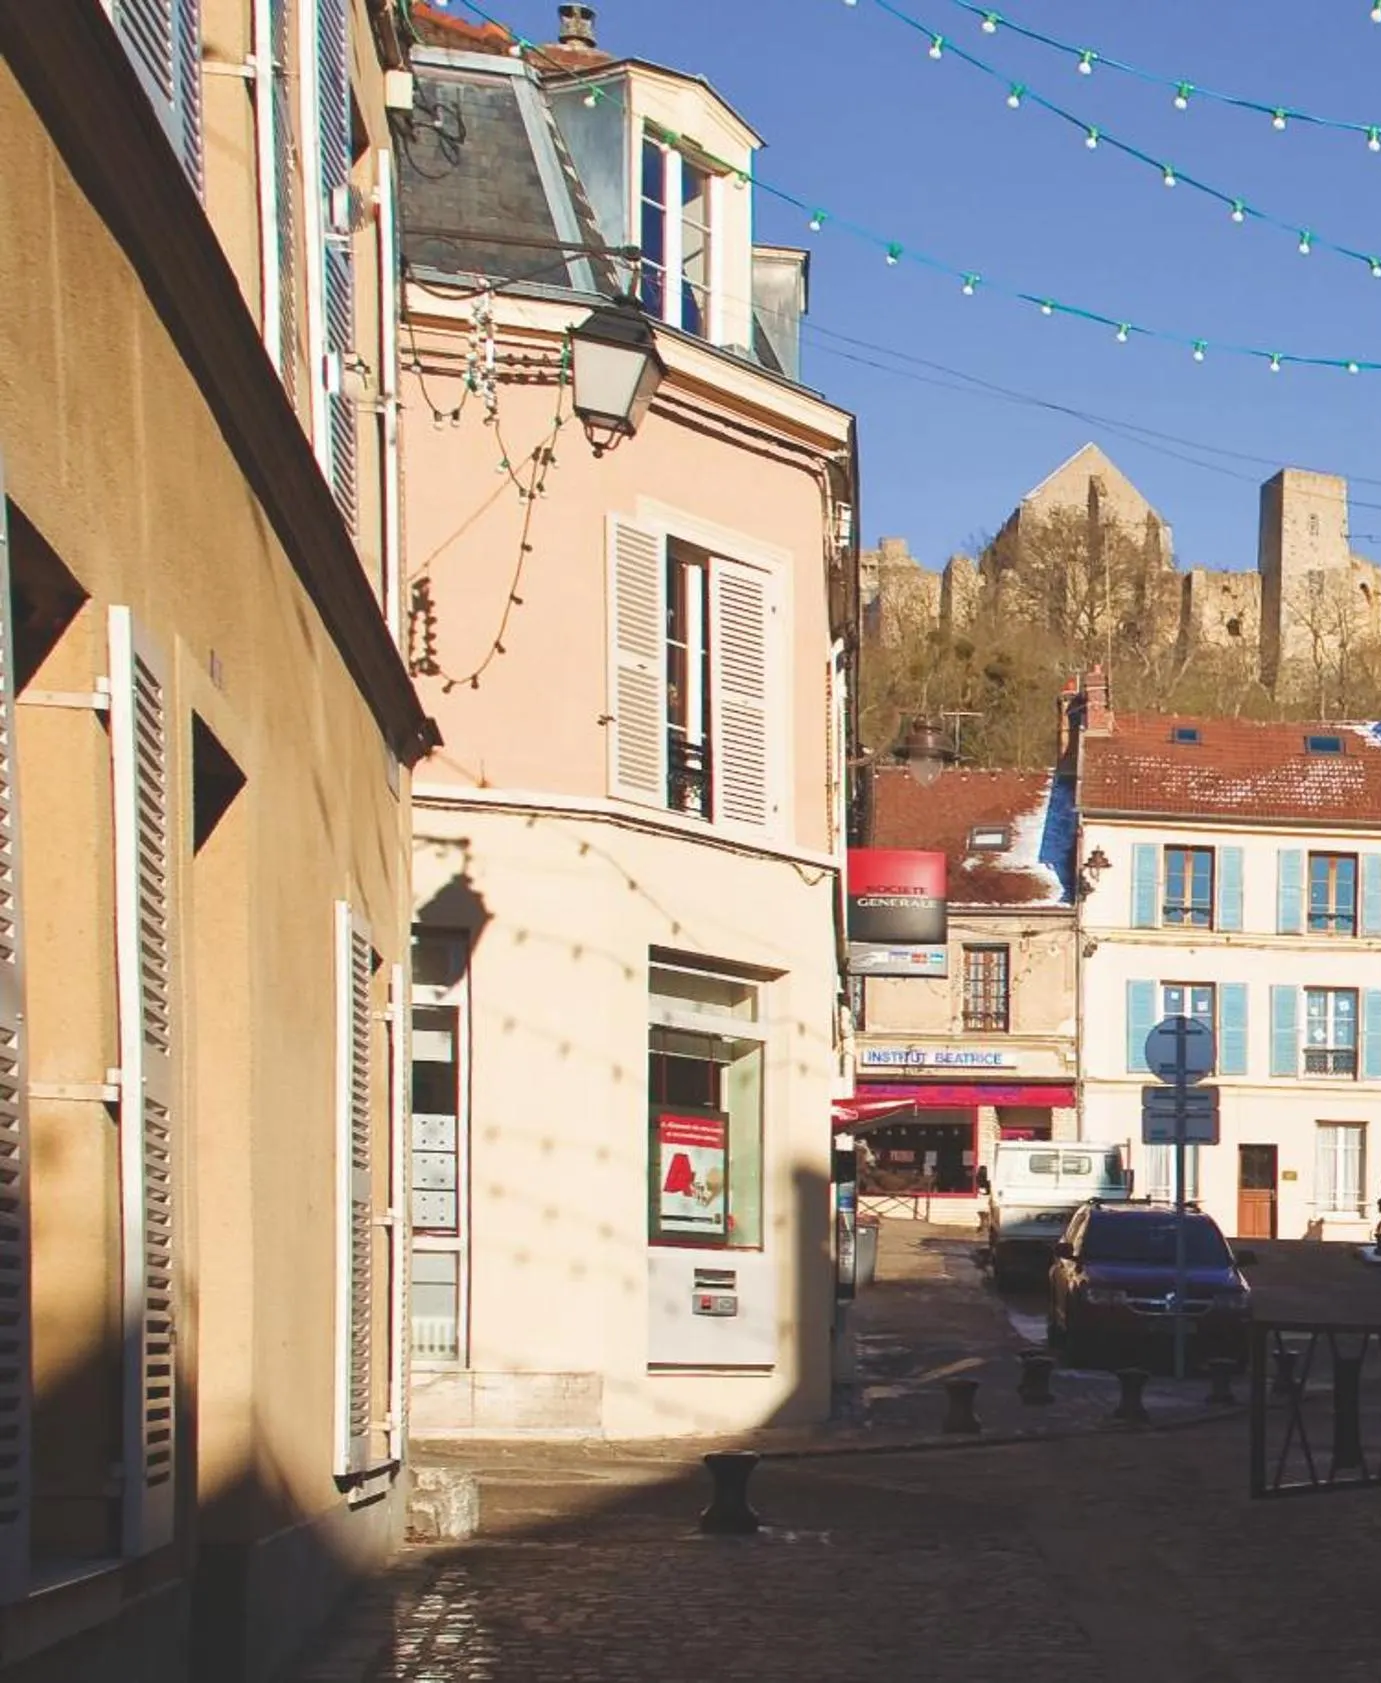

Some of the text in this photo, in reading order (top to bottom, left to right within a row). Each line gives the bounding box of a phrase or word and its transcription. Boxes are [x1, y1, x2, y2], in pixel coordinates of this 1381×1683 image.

[857, 897, 937, 909] GENERALE
[867, 1050, 1003, 1066] INSTITUT BEATRICE
